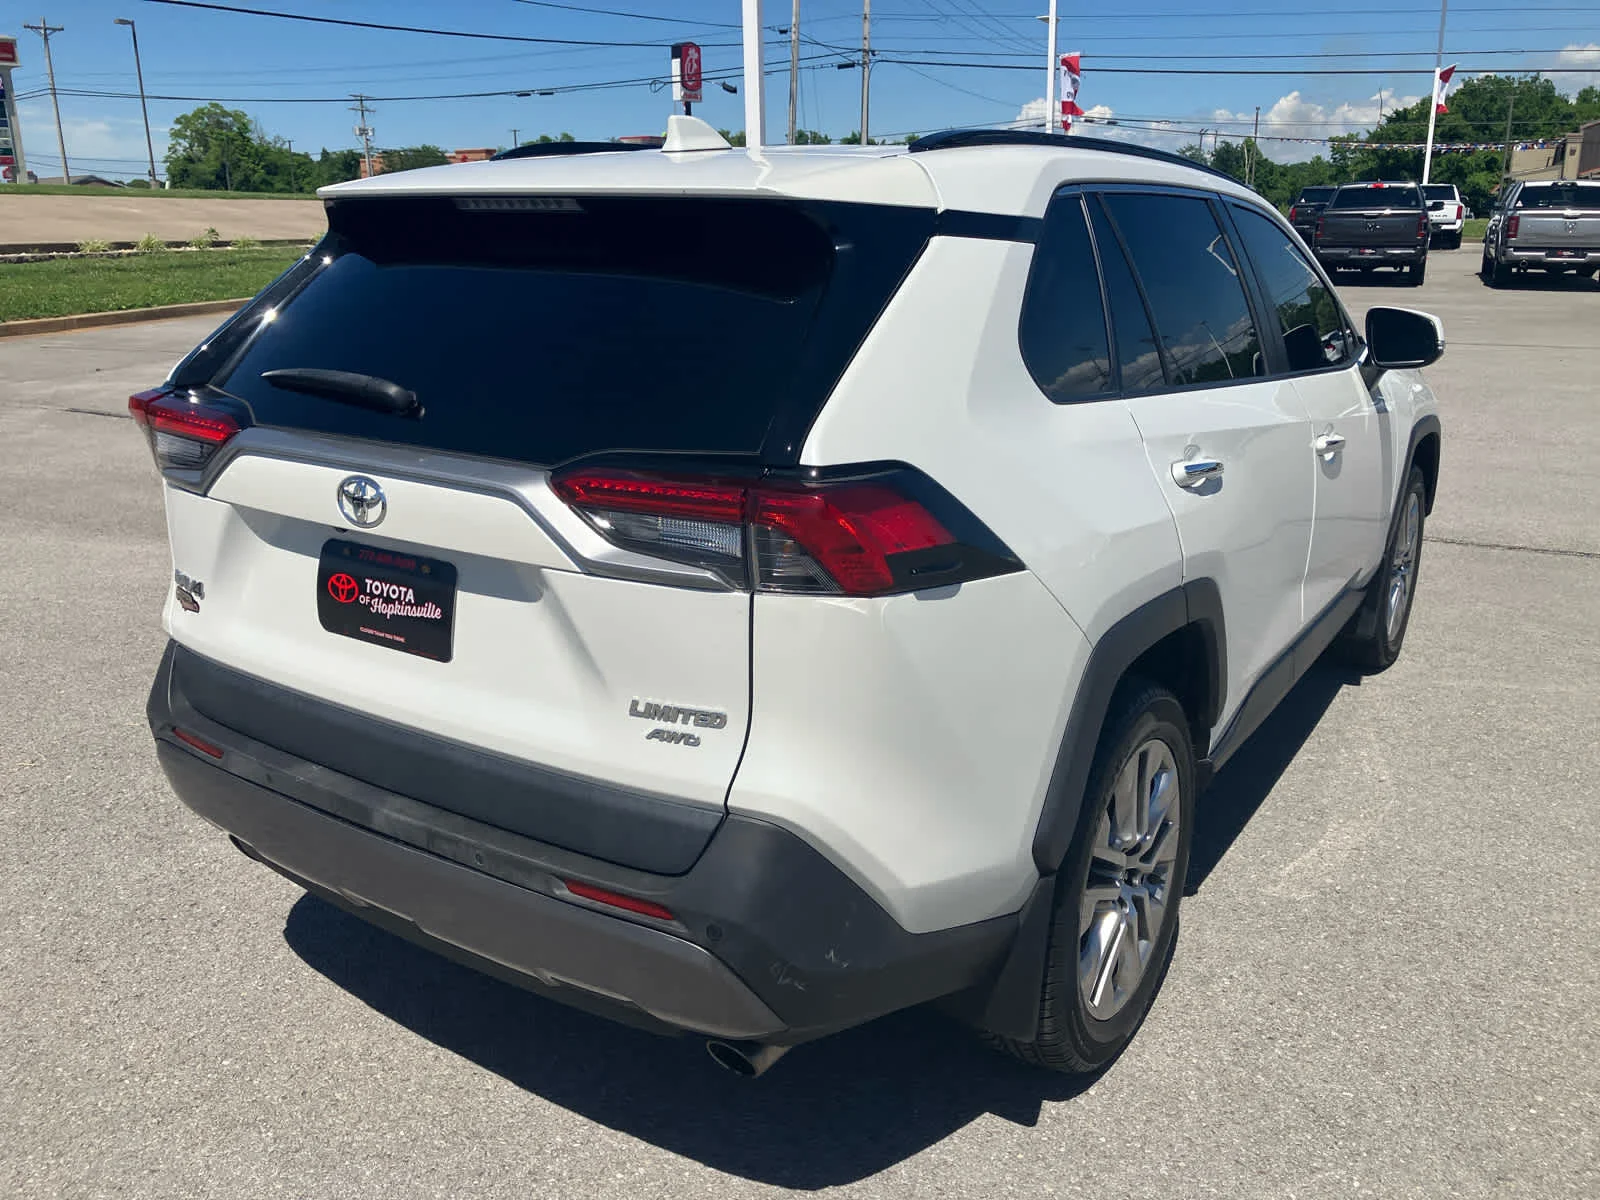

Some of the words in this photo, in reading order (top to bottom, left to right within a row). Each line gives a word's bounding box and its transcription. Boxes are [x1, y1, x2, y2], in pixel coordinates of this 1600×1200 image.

[364, 578, 415, 604] TOYOTA
[358, 594, 371, 606] OF
[370, 597, 442, 620] Hopkinsville
[628, 699, 728, 730] LIMITED
[645, 728, 702, 747] AWD
